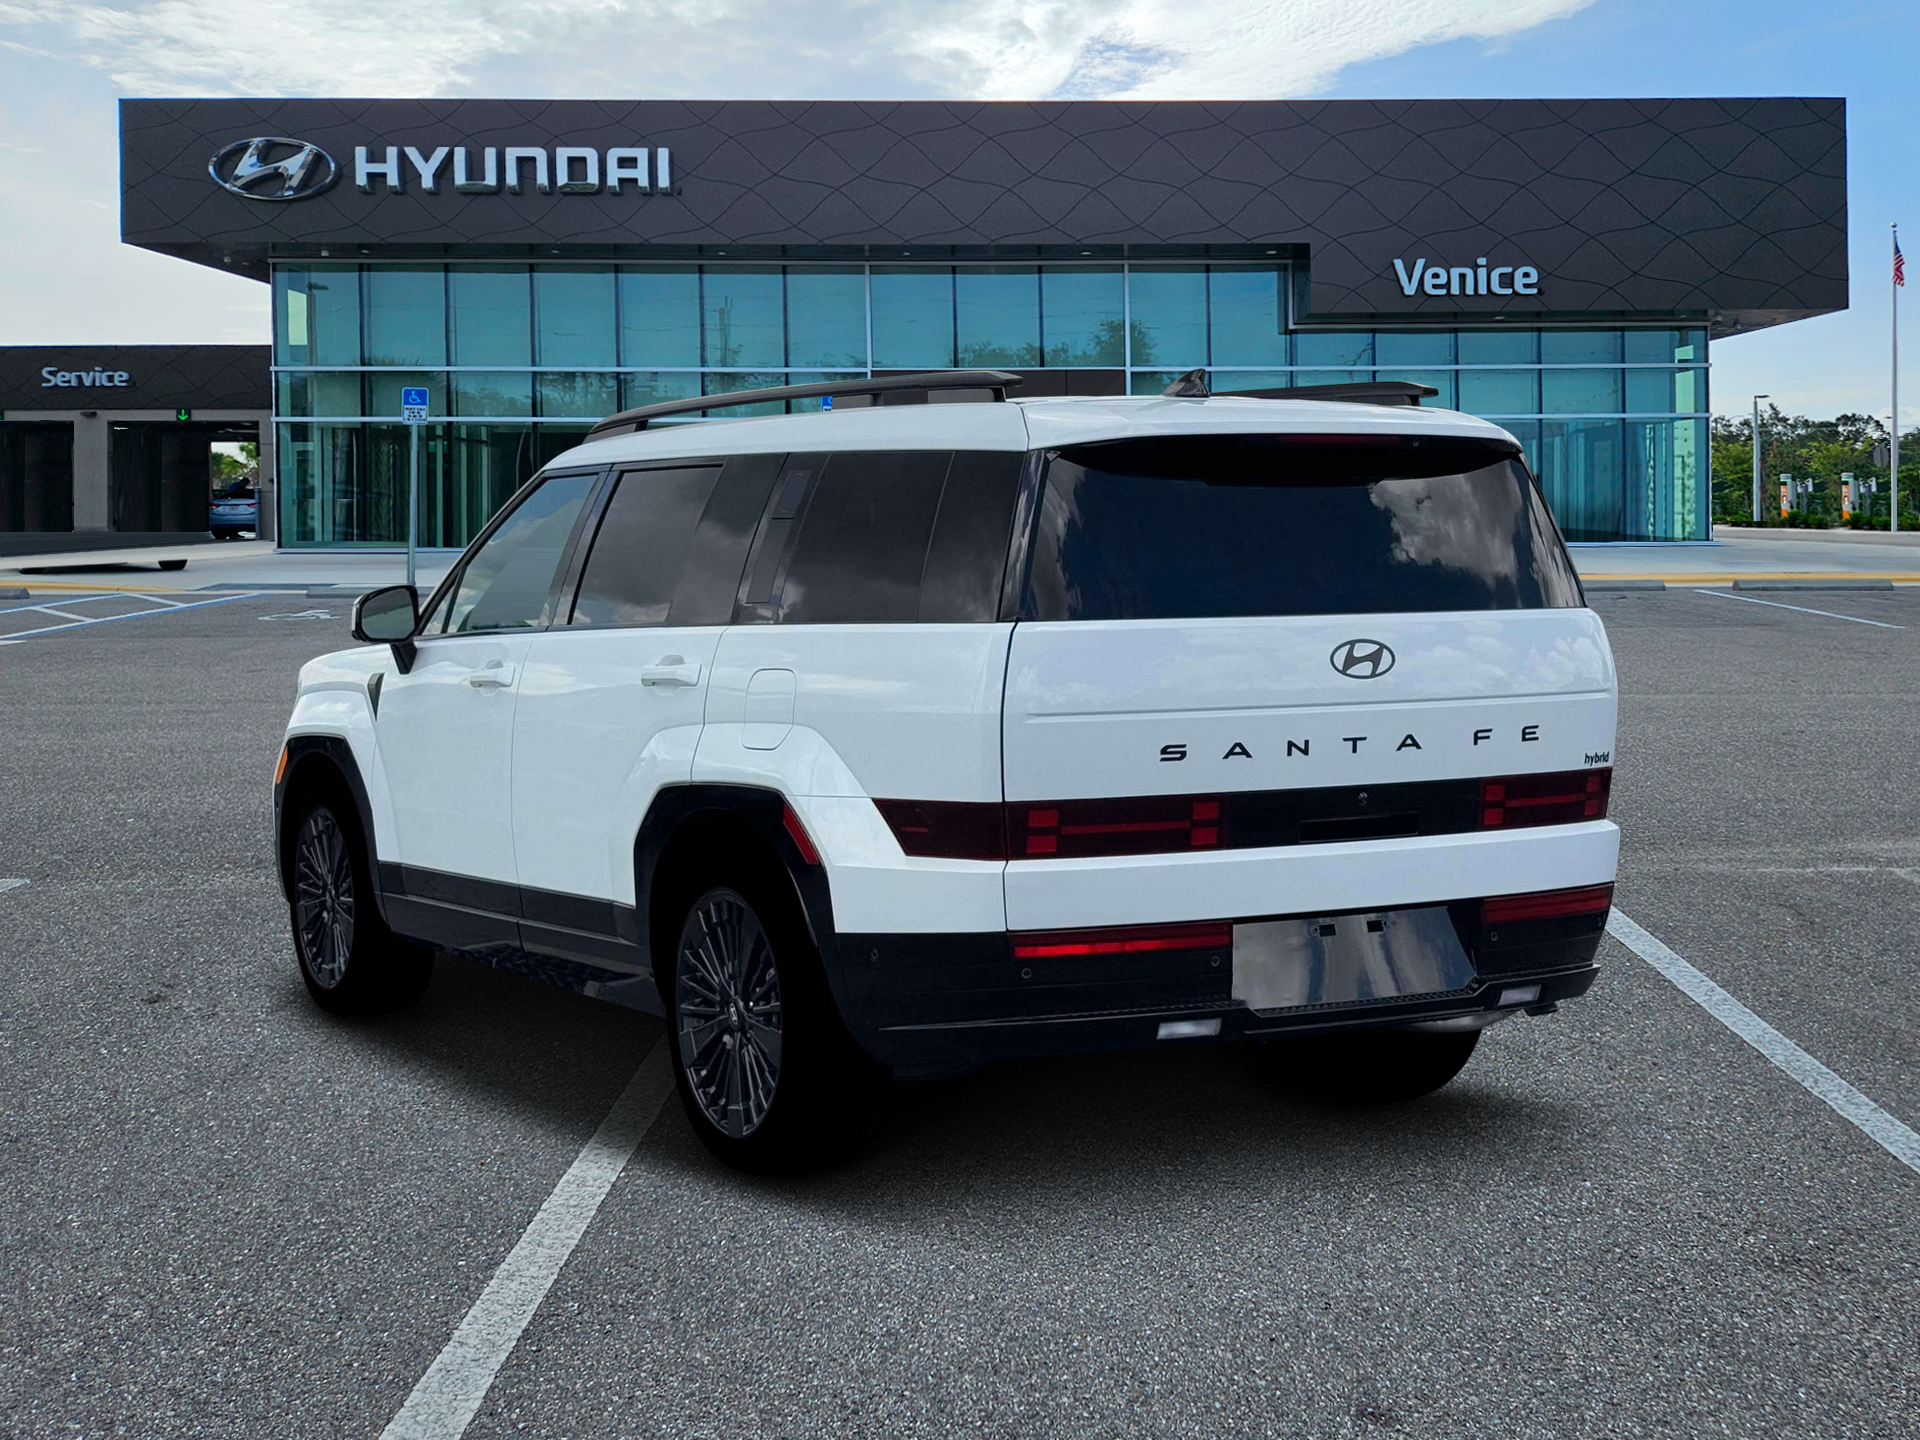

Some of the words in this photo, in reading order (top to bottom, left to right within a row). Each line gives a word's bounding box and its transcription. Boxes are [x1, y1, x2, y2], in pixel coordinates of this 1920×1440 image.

[354, 146, 672, 194] HYUNDAI
[1392, 257, 1539, 296] Venice
[41, 366, 130, 388] Service
[1159, 733, 1423, 763] SANTA
[1473, 724, 1540, 746] FE
[1584, 750, 1610, 767] hybrid
